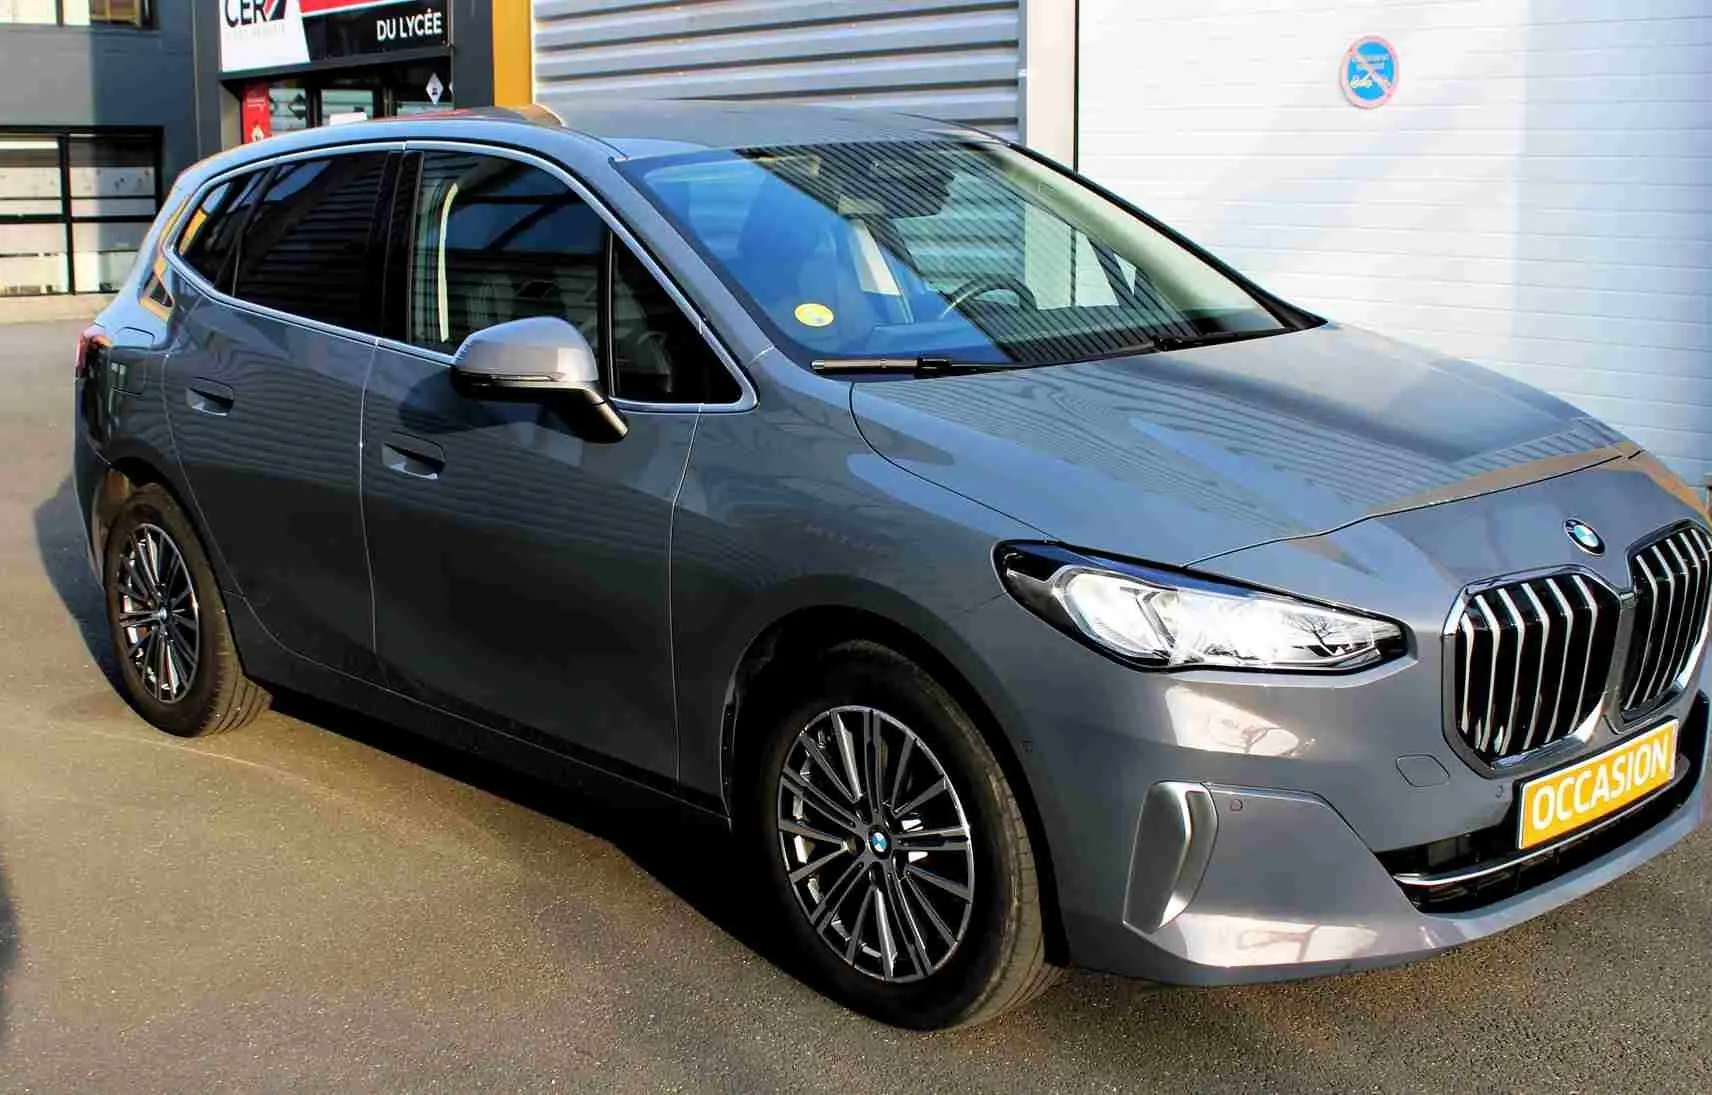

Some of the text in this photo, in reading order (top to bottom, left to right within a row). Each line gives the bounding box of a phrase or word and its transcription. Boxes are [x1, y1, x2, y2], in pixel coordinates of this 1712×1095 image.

[376, 8, 442, 41] DU LYCÉE
[1532, 731, 1669, 830] OCCASION
